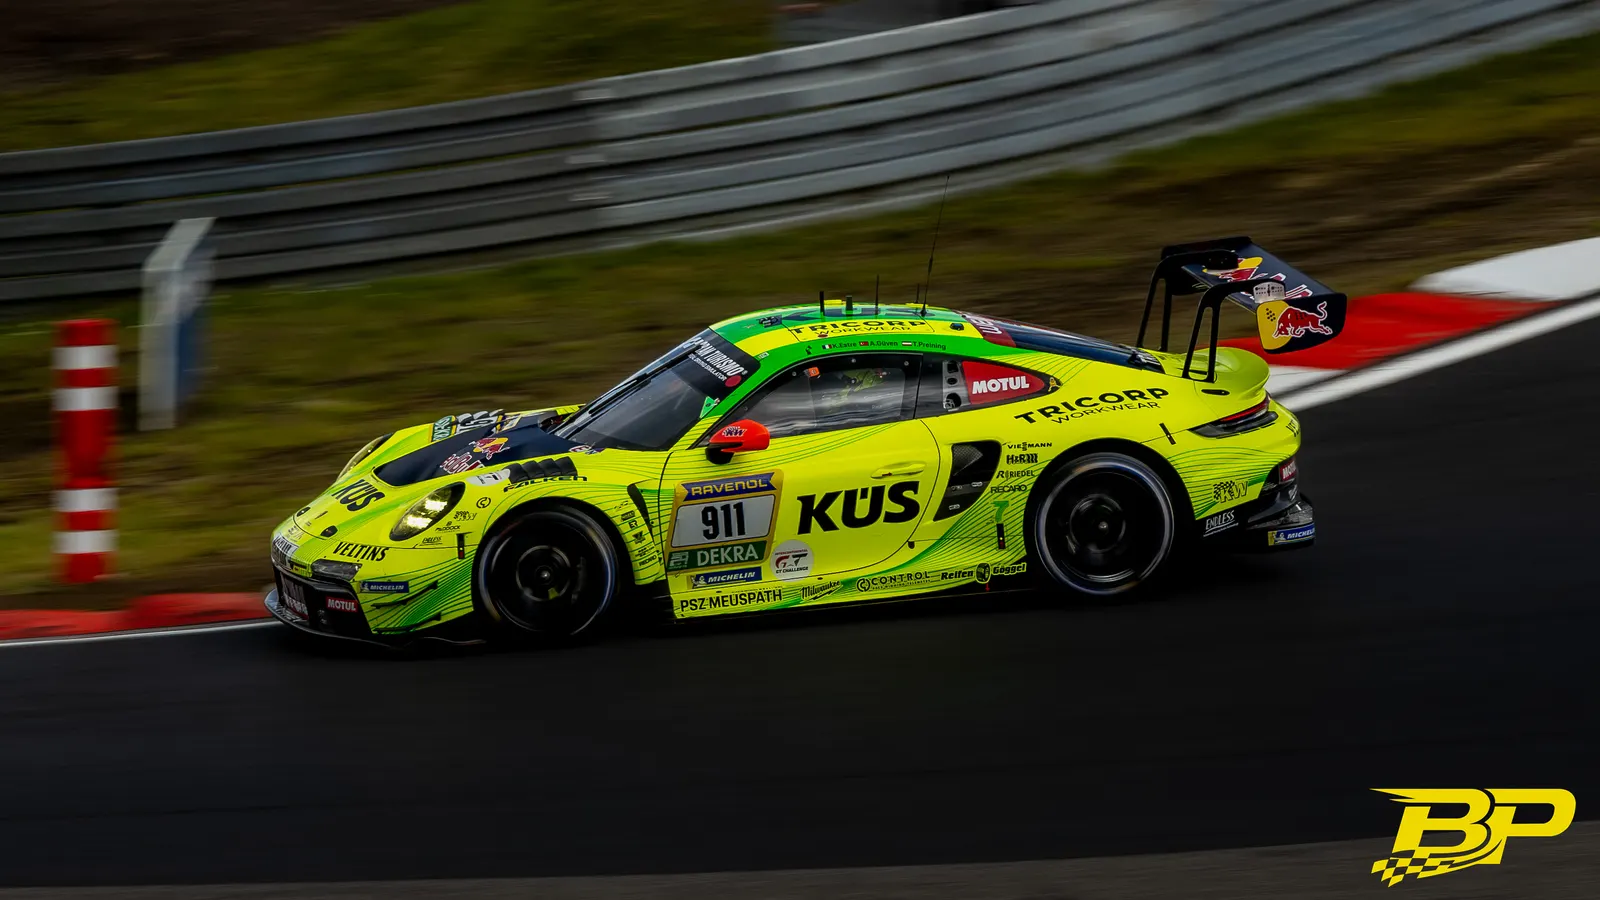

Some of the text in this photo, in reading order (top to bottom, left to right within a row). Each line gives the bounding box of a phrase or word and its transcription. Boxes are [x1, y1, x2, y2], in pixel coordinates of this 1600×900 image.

[790, 320, 926, 334] TRICORP
[815, 326, 912, 336] WORKWEAR
[913, 341, 947, 350] T.Preining
[972, 375, 1030, 394] MOTUL
[1014, 387, 1169, 424] TRICORP
[1051, 401, 1161, 425] WORKWEAR
[331, 479, 385, 512] KÜS
[691, 478, 768, 496] RAVENOL
[990, 484, 1027, 493] RECARO
[797, 481, 920, 535] KÜS
[701, 501, 746, 540] 911
[1206, 510, 1235, 530] ENDLESS
[333, 541, 389, 561] VELTINS
[697, 544, 759, 566] DEKRA
[708, 572, 756, 583] MICHELIN
[871, 571, 930, 585] CONTROL
[941, 570, 974, 580] Reifen
[327, 598, 356, 611] MOTUL
[680, 589, 782, 612] PSZ MEUSPATH
